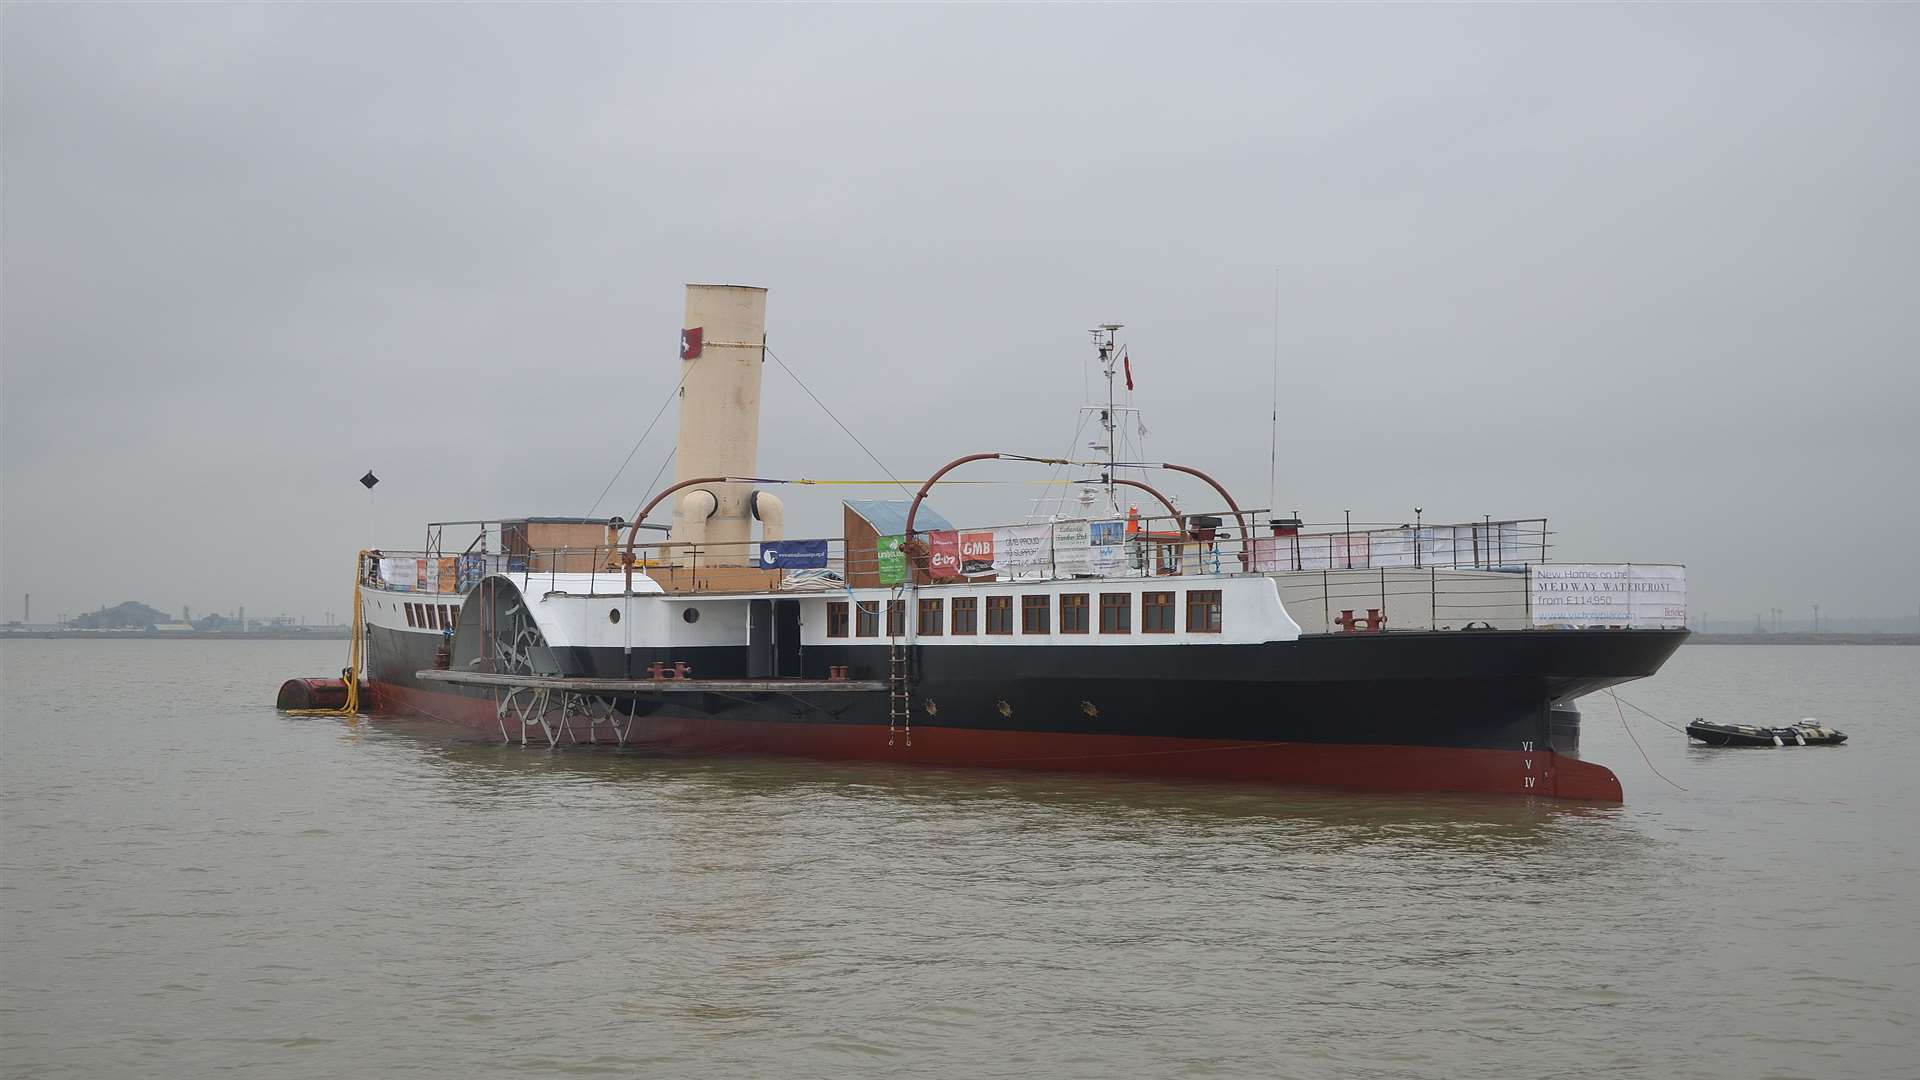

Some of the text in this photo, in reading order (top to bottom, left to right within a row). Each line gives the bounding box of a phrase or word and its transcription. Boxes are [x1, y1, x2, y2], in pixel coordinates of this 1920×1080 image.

[1020, 536, 1039, 545] PROUD
[963, 541, 990, 555] GMB
[1537, 570, 1627, 579] New Homes on the
[1538, 582, 1672, 592] MEDWAY WATERFRONT
[1538, 595, 1563, 605] from
[1522, 741, 1533, 751] VI
[1525, 759, 1532, 770] V
[1525, 777, 1536, 788] IV
